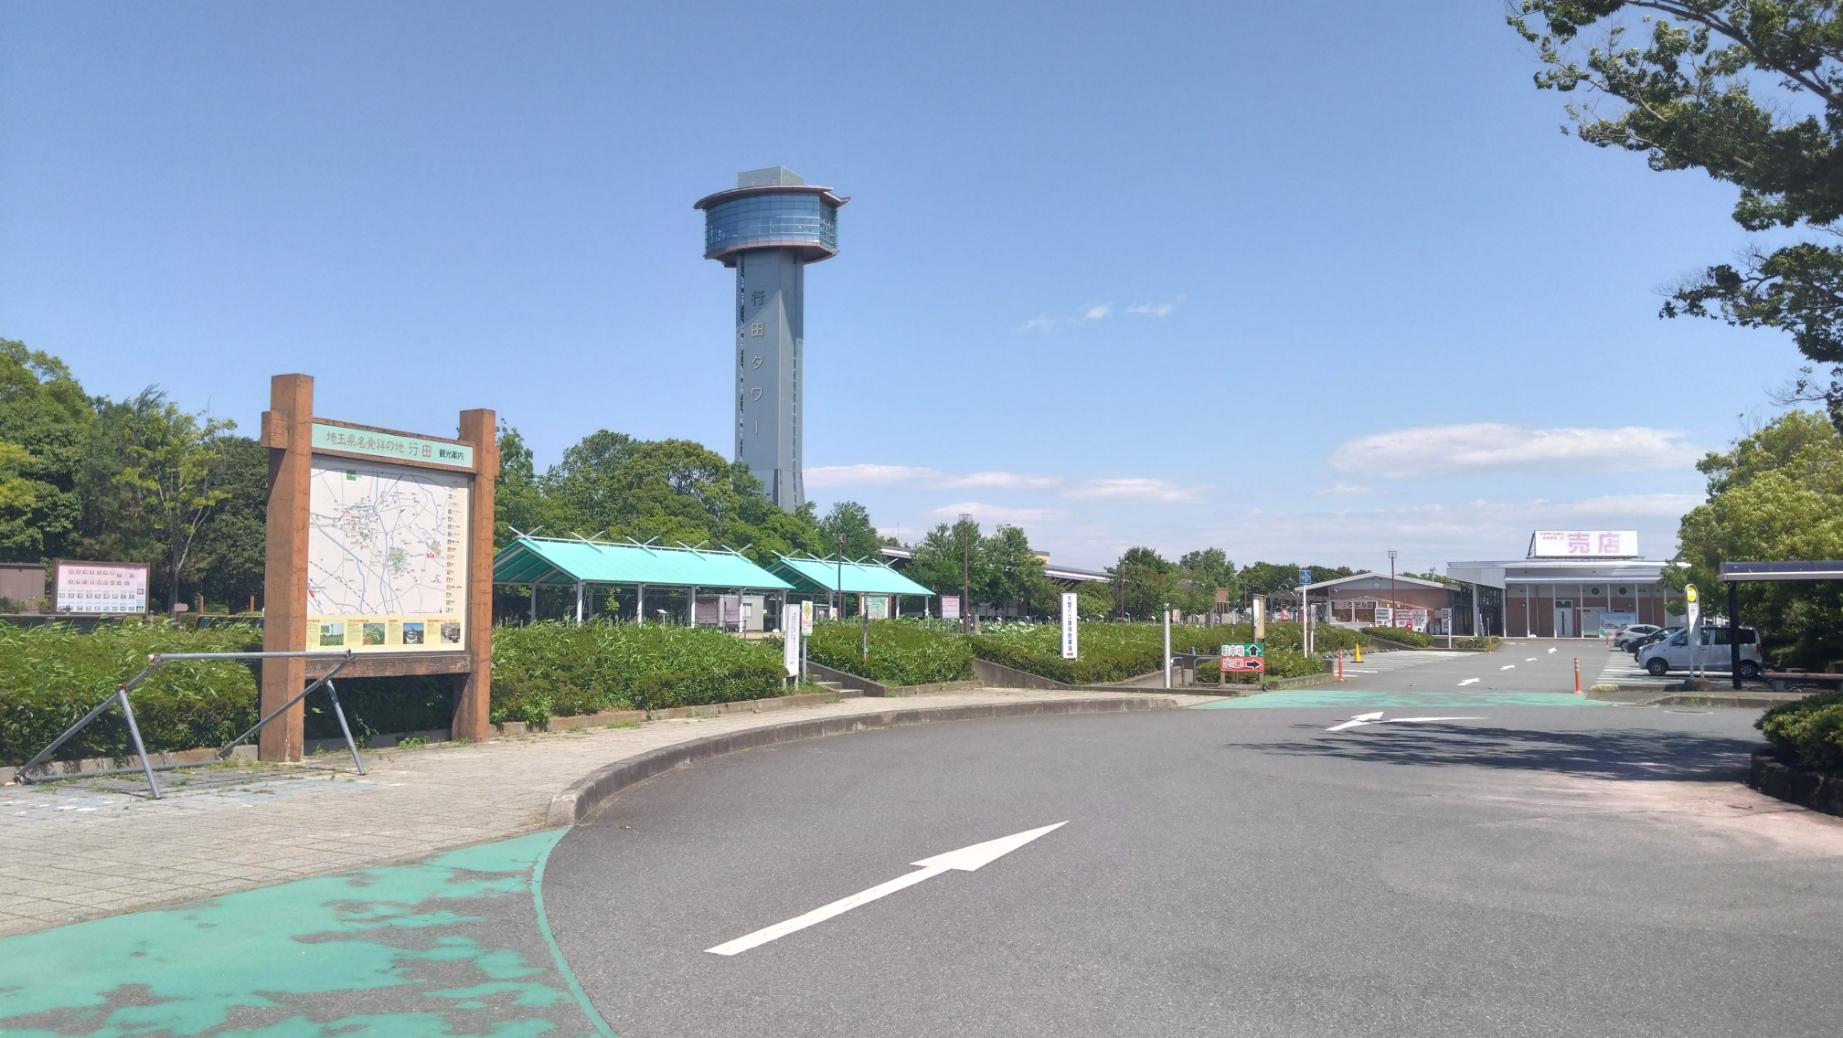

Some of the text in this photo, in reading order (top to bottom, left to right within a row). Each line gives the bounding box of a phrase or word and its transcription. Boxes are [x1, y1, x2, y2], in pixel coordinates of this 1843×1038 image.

[751, 290, 765, 435] 行田タワー
[326, 431, 465, 461] 埼玉県名発祥の地 行田 観光案内
[1568, 532, 1620, 554] 売店
[1221, 645, 1245, 657] 駐車場
[1223, 658, 1244, 669] 出口
